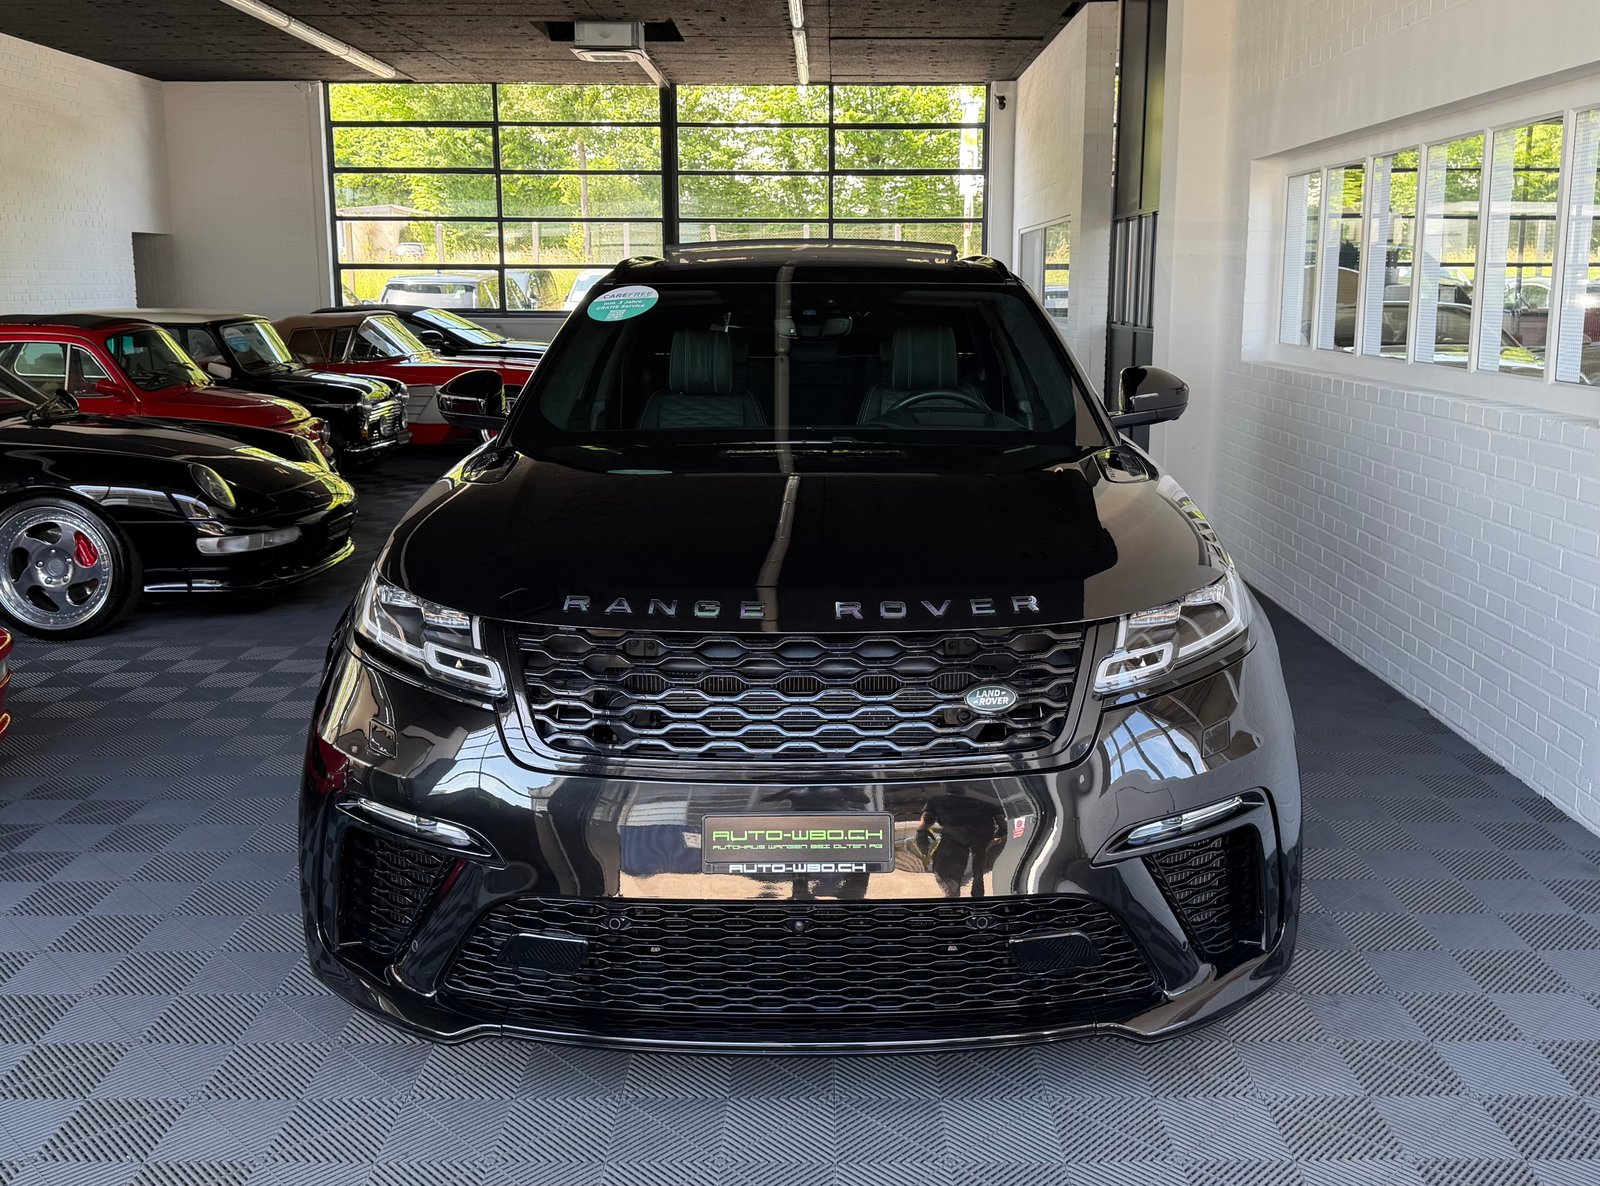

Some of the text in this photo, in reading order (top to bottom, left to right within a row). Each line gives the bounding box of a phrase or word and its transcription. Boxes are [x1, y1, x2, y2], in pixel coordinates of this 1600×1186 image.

[603, 291, 654, 300] CAREFREE
[562, 595, 1040, 619] RANGE ROVER
[976, 689, 1000, 698] LAND
[979, 696, 1009, 706] ROVER
[712, 829, 883, 841] AUTO-WBO.CH
[728, 863, 867, 873] AUTO-WBO.CH
